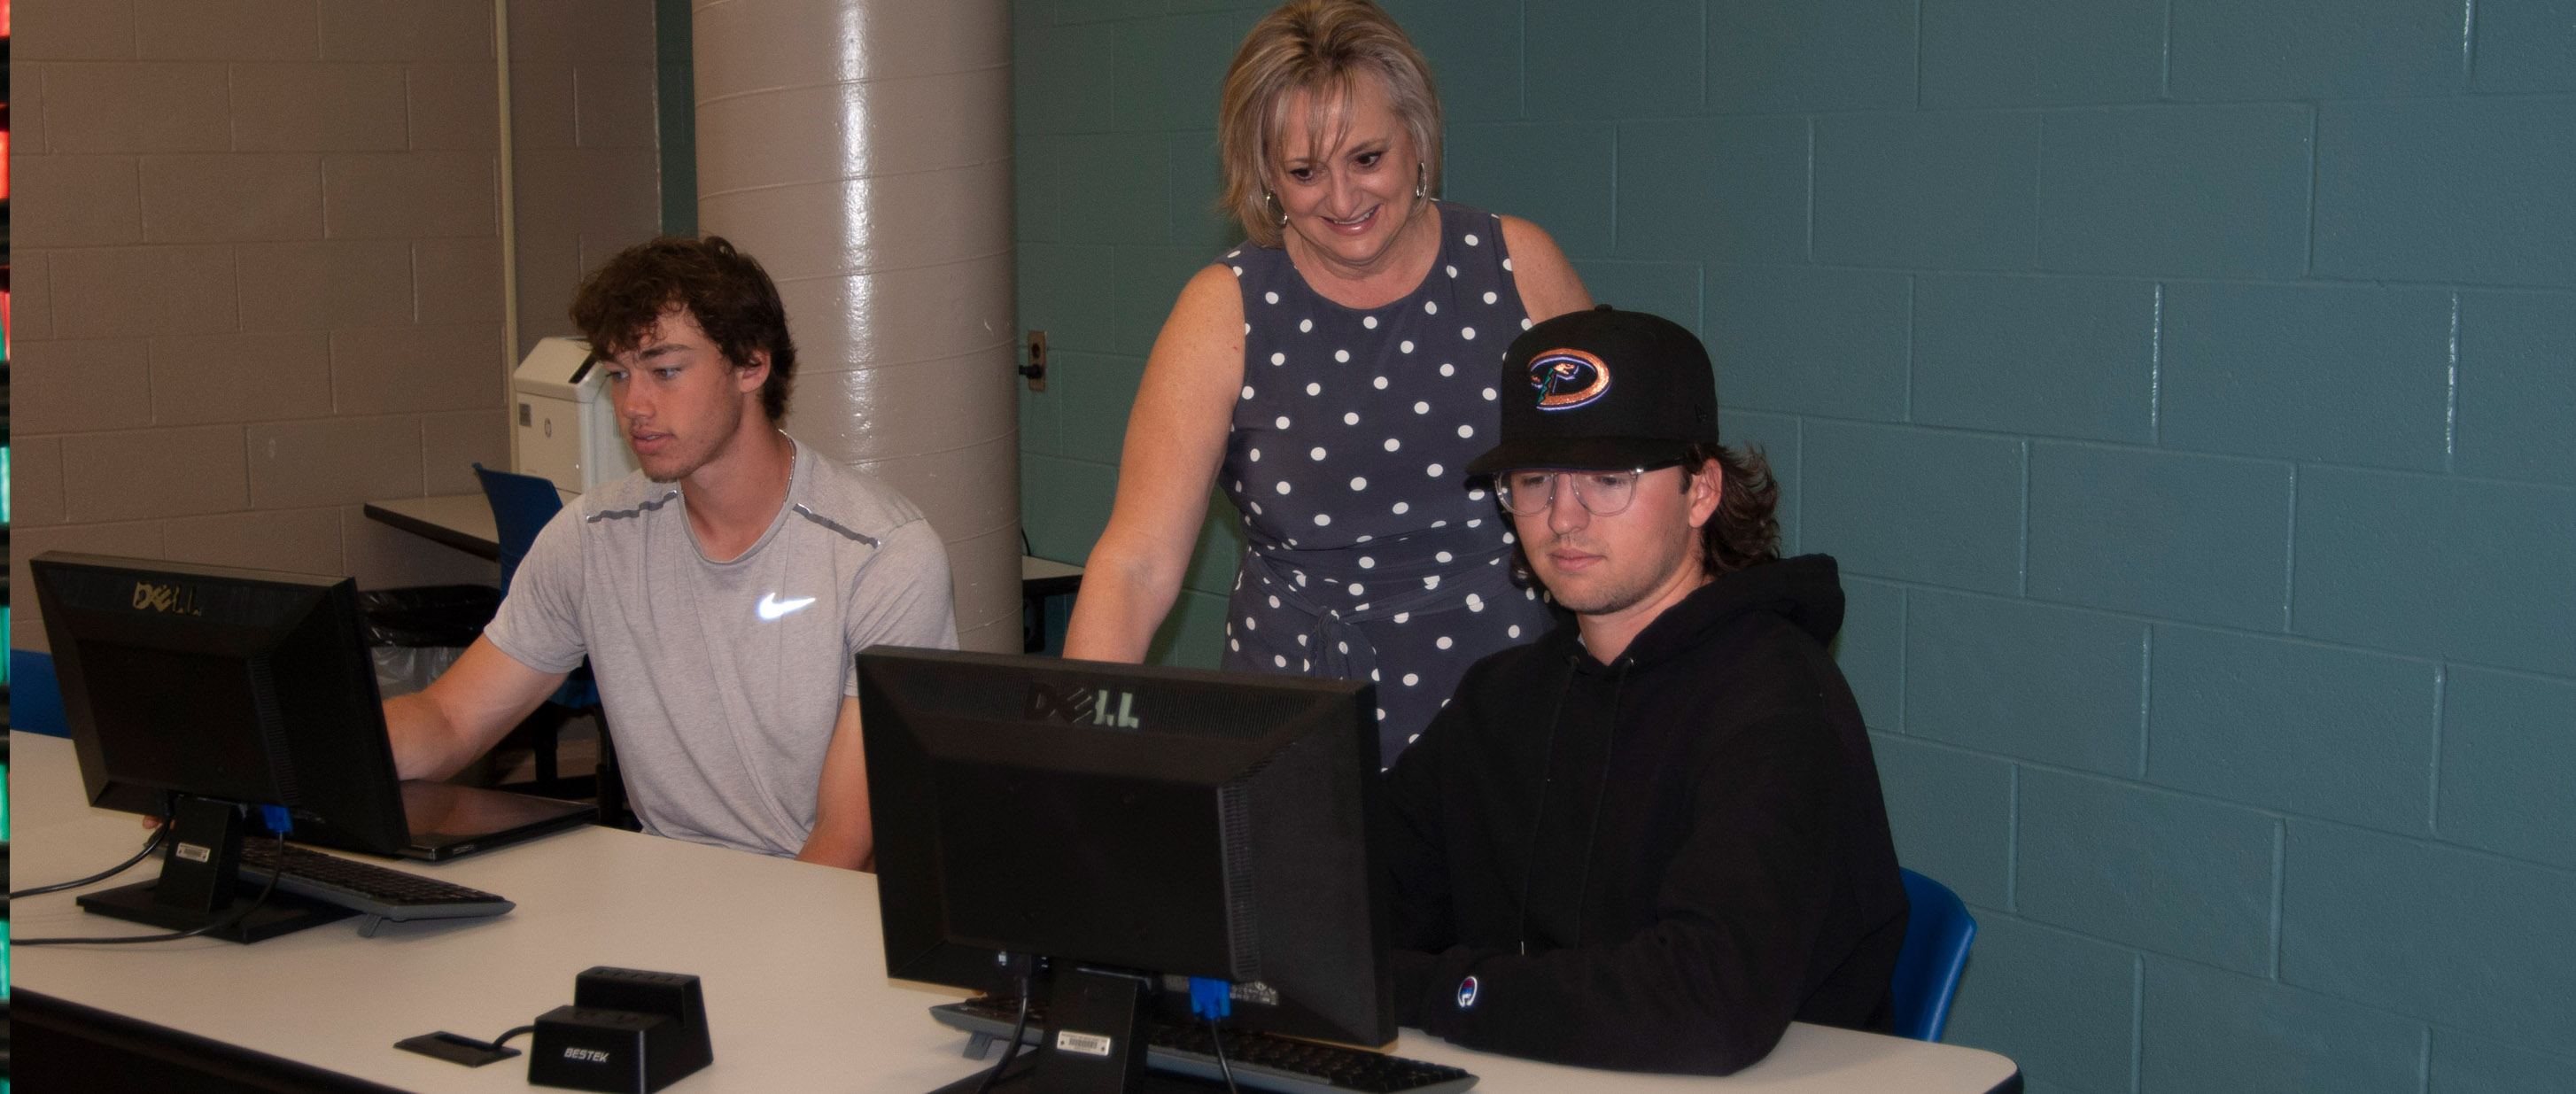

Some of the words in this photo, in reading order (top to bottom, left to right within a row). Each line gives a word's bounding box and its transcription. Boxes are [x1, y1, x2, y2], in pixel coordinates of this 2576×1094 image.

[134, 582, 200, 616] DELL
[1026, 682, 1139, 729] DELL
[564, 1047, 609, 1062] BESTEK
